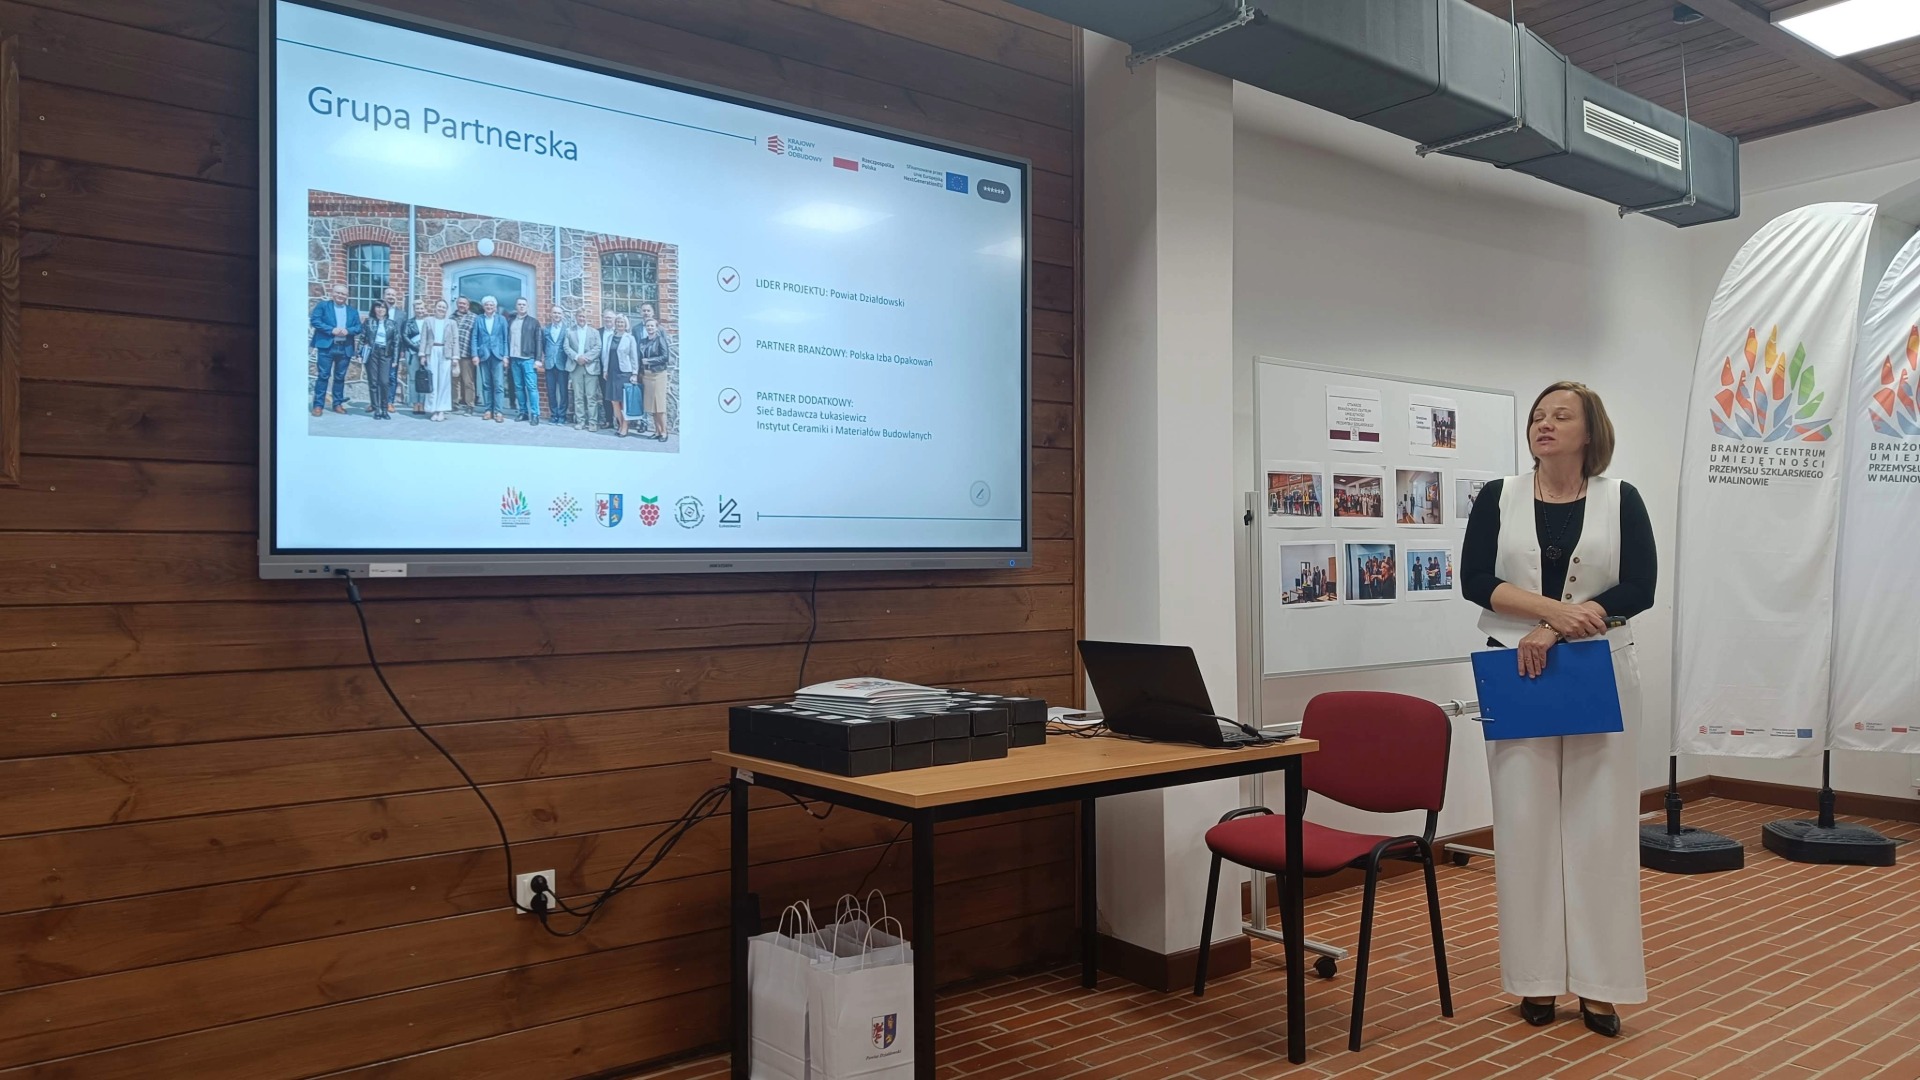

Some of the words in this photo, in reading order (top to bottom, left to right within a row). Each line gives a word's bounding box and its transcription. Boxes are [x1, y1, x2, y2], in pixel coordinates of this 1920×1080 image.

[308, 86, 410, 131] Grupa
[423, 107, 578, 161] Partnerska
[788, 138, 815, 148] KRAJOWY
[788, 151, 822, 162] ODBUDOWY
[756, 278, 781, 291] LIDER
[783, 282, 828, 297] PROJEKTU:
[830, 289, 857, 301] Powiat
[859, 293, 905, 308] Działdowski
[756, 340, 796, 353] PARTNER
[798, 344, 848, 358] BRANŻOWY:
[850, 350, 875, 361] Polska
[876, 353, 892, 363] Izba
[893, 355, 933, 367] Opakowań
[757, 391, 796, 403] PARTNER
[798, 395, 854, 407] DODATKOWY:
[757, 406, 774, 416] Sieć
[777, 407, 818, 419] Badawcza
[820, 410, 867, 422] Łukasiewicz
[757, 421, 790, 433] Instytut
[792, 422, 829, 434] Ceramiki
[830, 425, 834, 434] i
[835, 425, 880, 438] Materiałów
[882, 428, 932, 441] Budowlanych
[1711, 444, 1769, 455] BRANŻOWE
[1775, 447, 1826, 458] CENTRUM
[1871, 442, 1920, 451] BRANŻO
[1709, 465, 1759, 475] PRZEMYSŁU
[1760, 467, 1824, 479] SZKLARSKIEGO
[1868, 474, 1877, 482] W
[1880, 474, 1920, 483] MALINO
[1708, 475, 1717, 484] W
[1719, 476, 1769, 486] MALINOWIE
